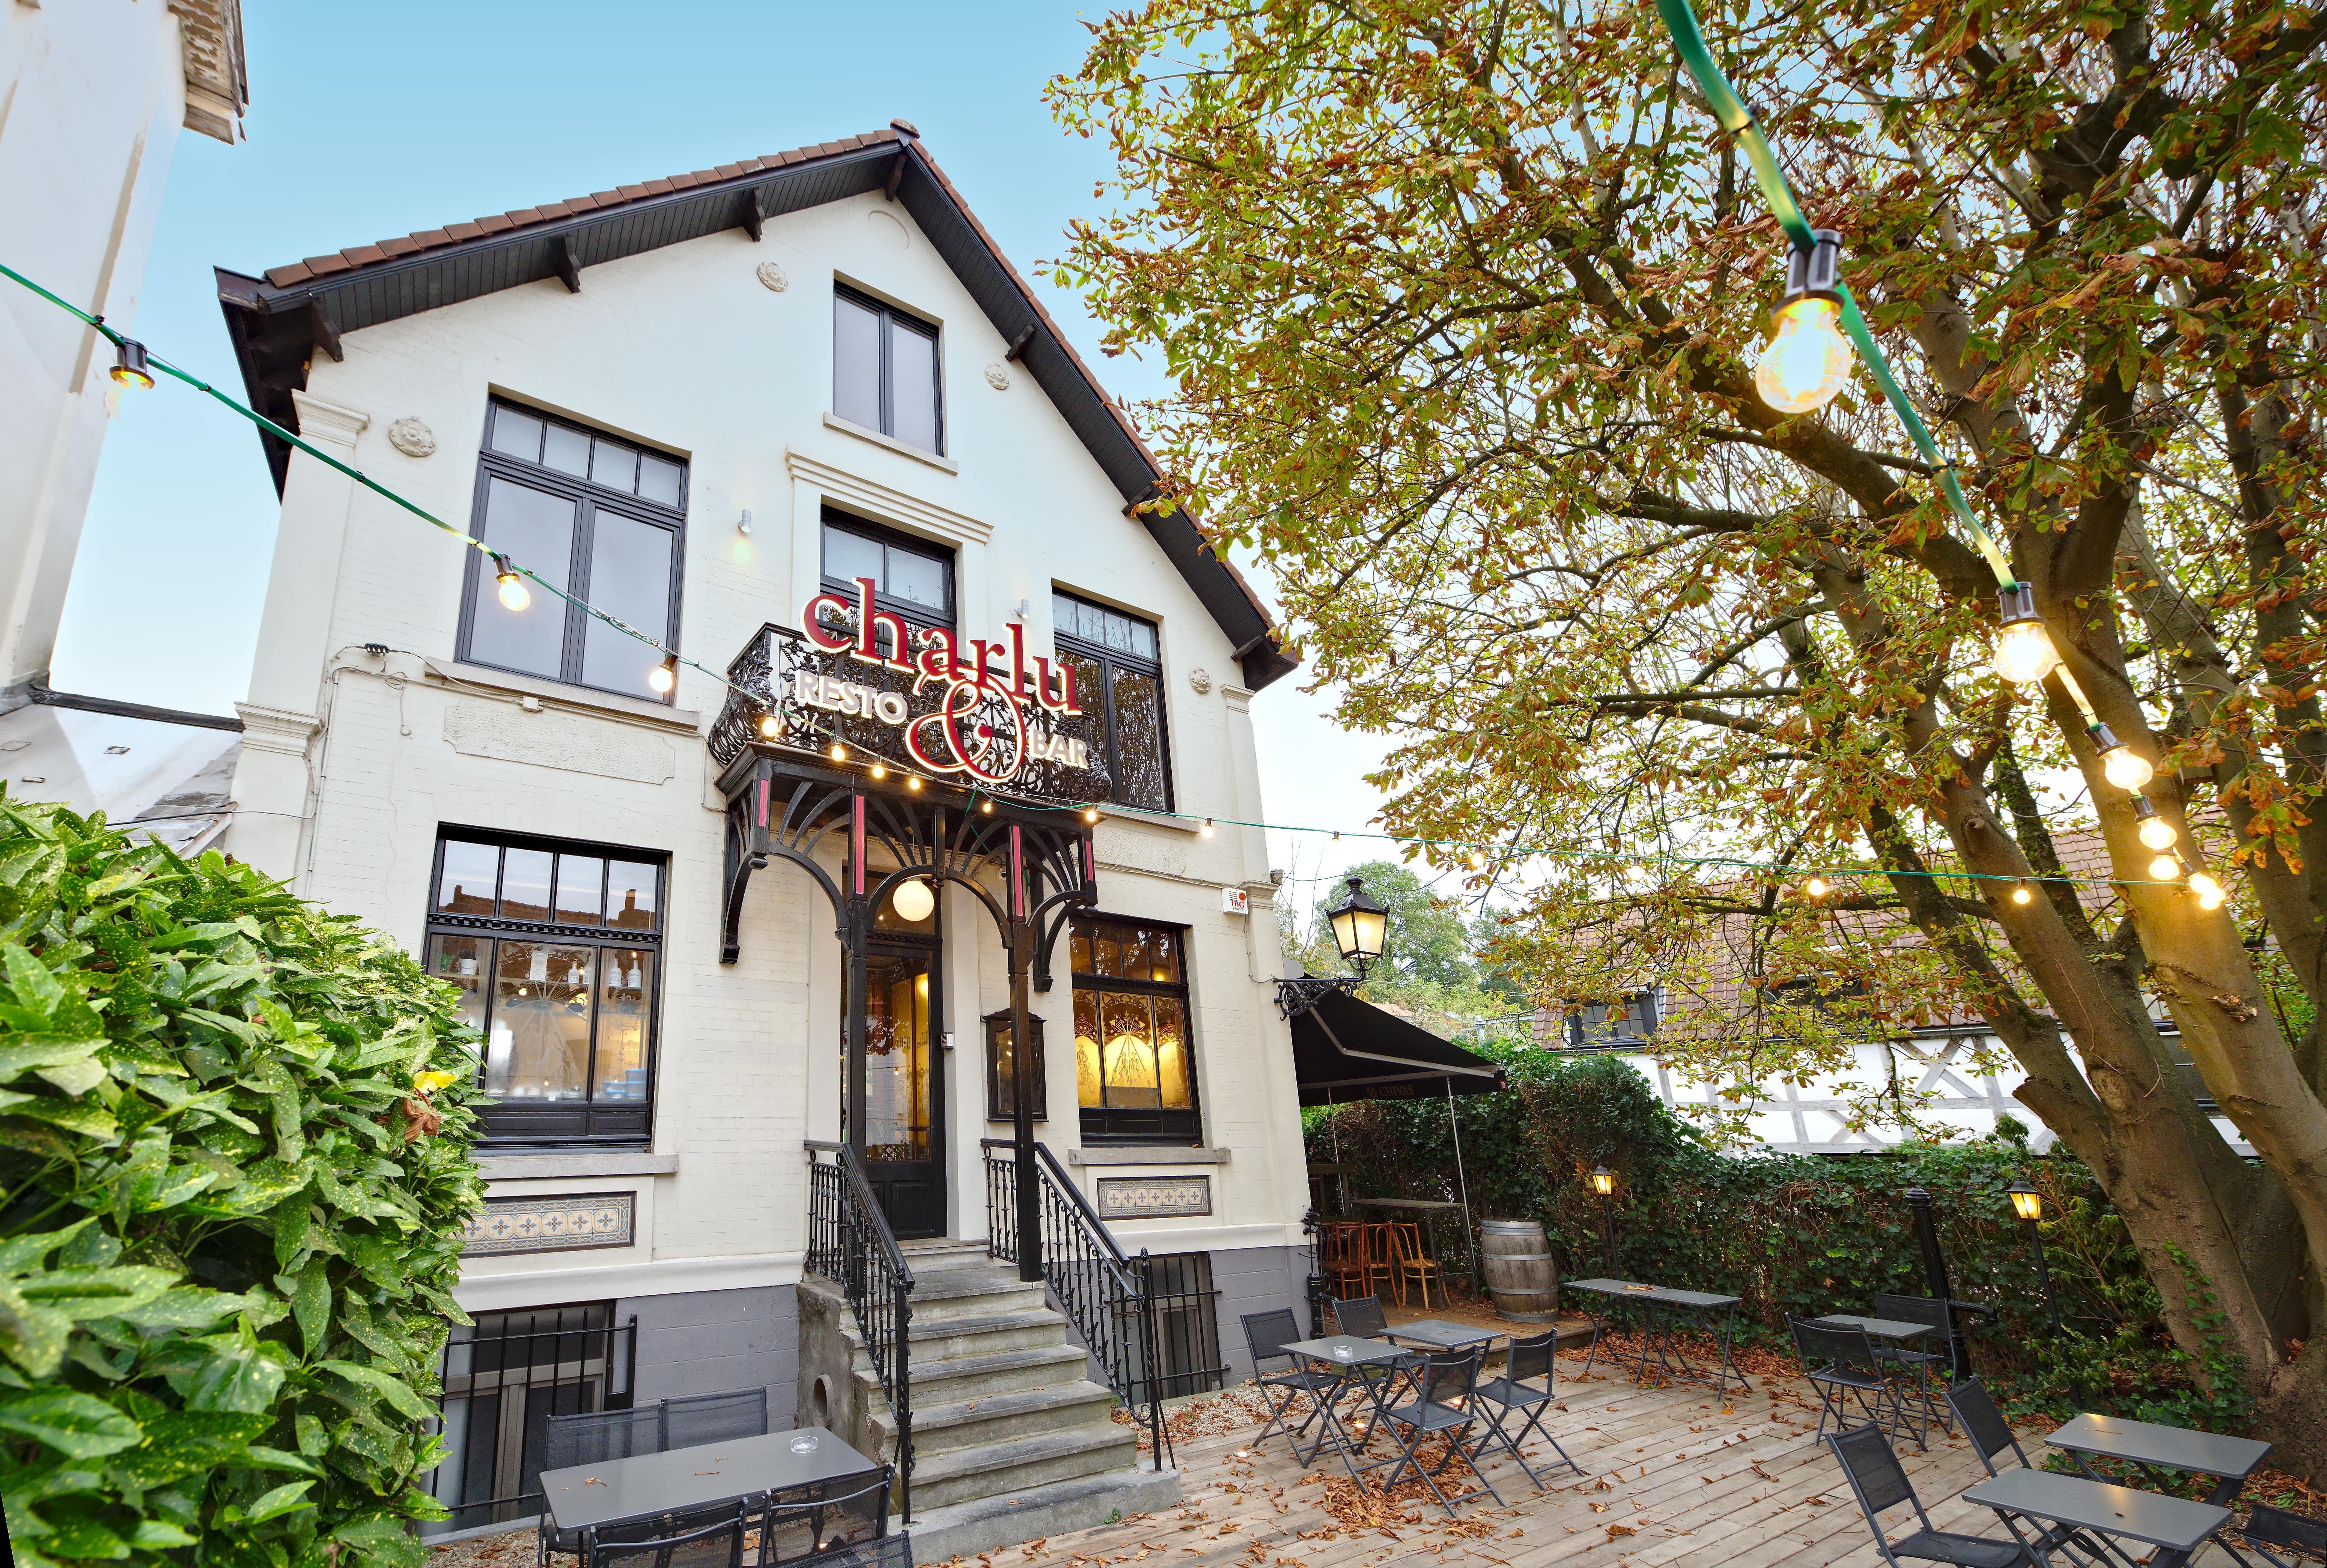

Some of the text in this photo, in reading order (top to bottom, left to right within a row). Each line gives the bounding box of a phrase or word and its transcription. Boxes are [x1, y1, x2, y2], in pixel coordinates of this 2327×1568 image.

[799, 577, 1082, 715] charlu
[795, 670, 908, 725] RESTO
[1029, 728, 1089, 770] BAR
[1379, 1085, 1415, 1097] CHIVAS
